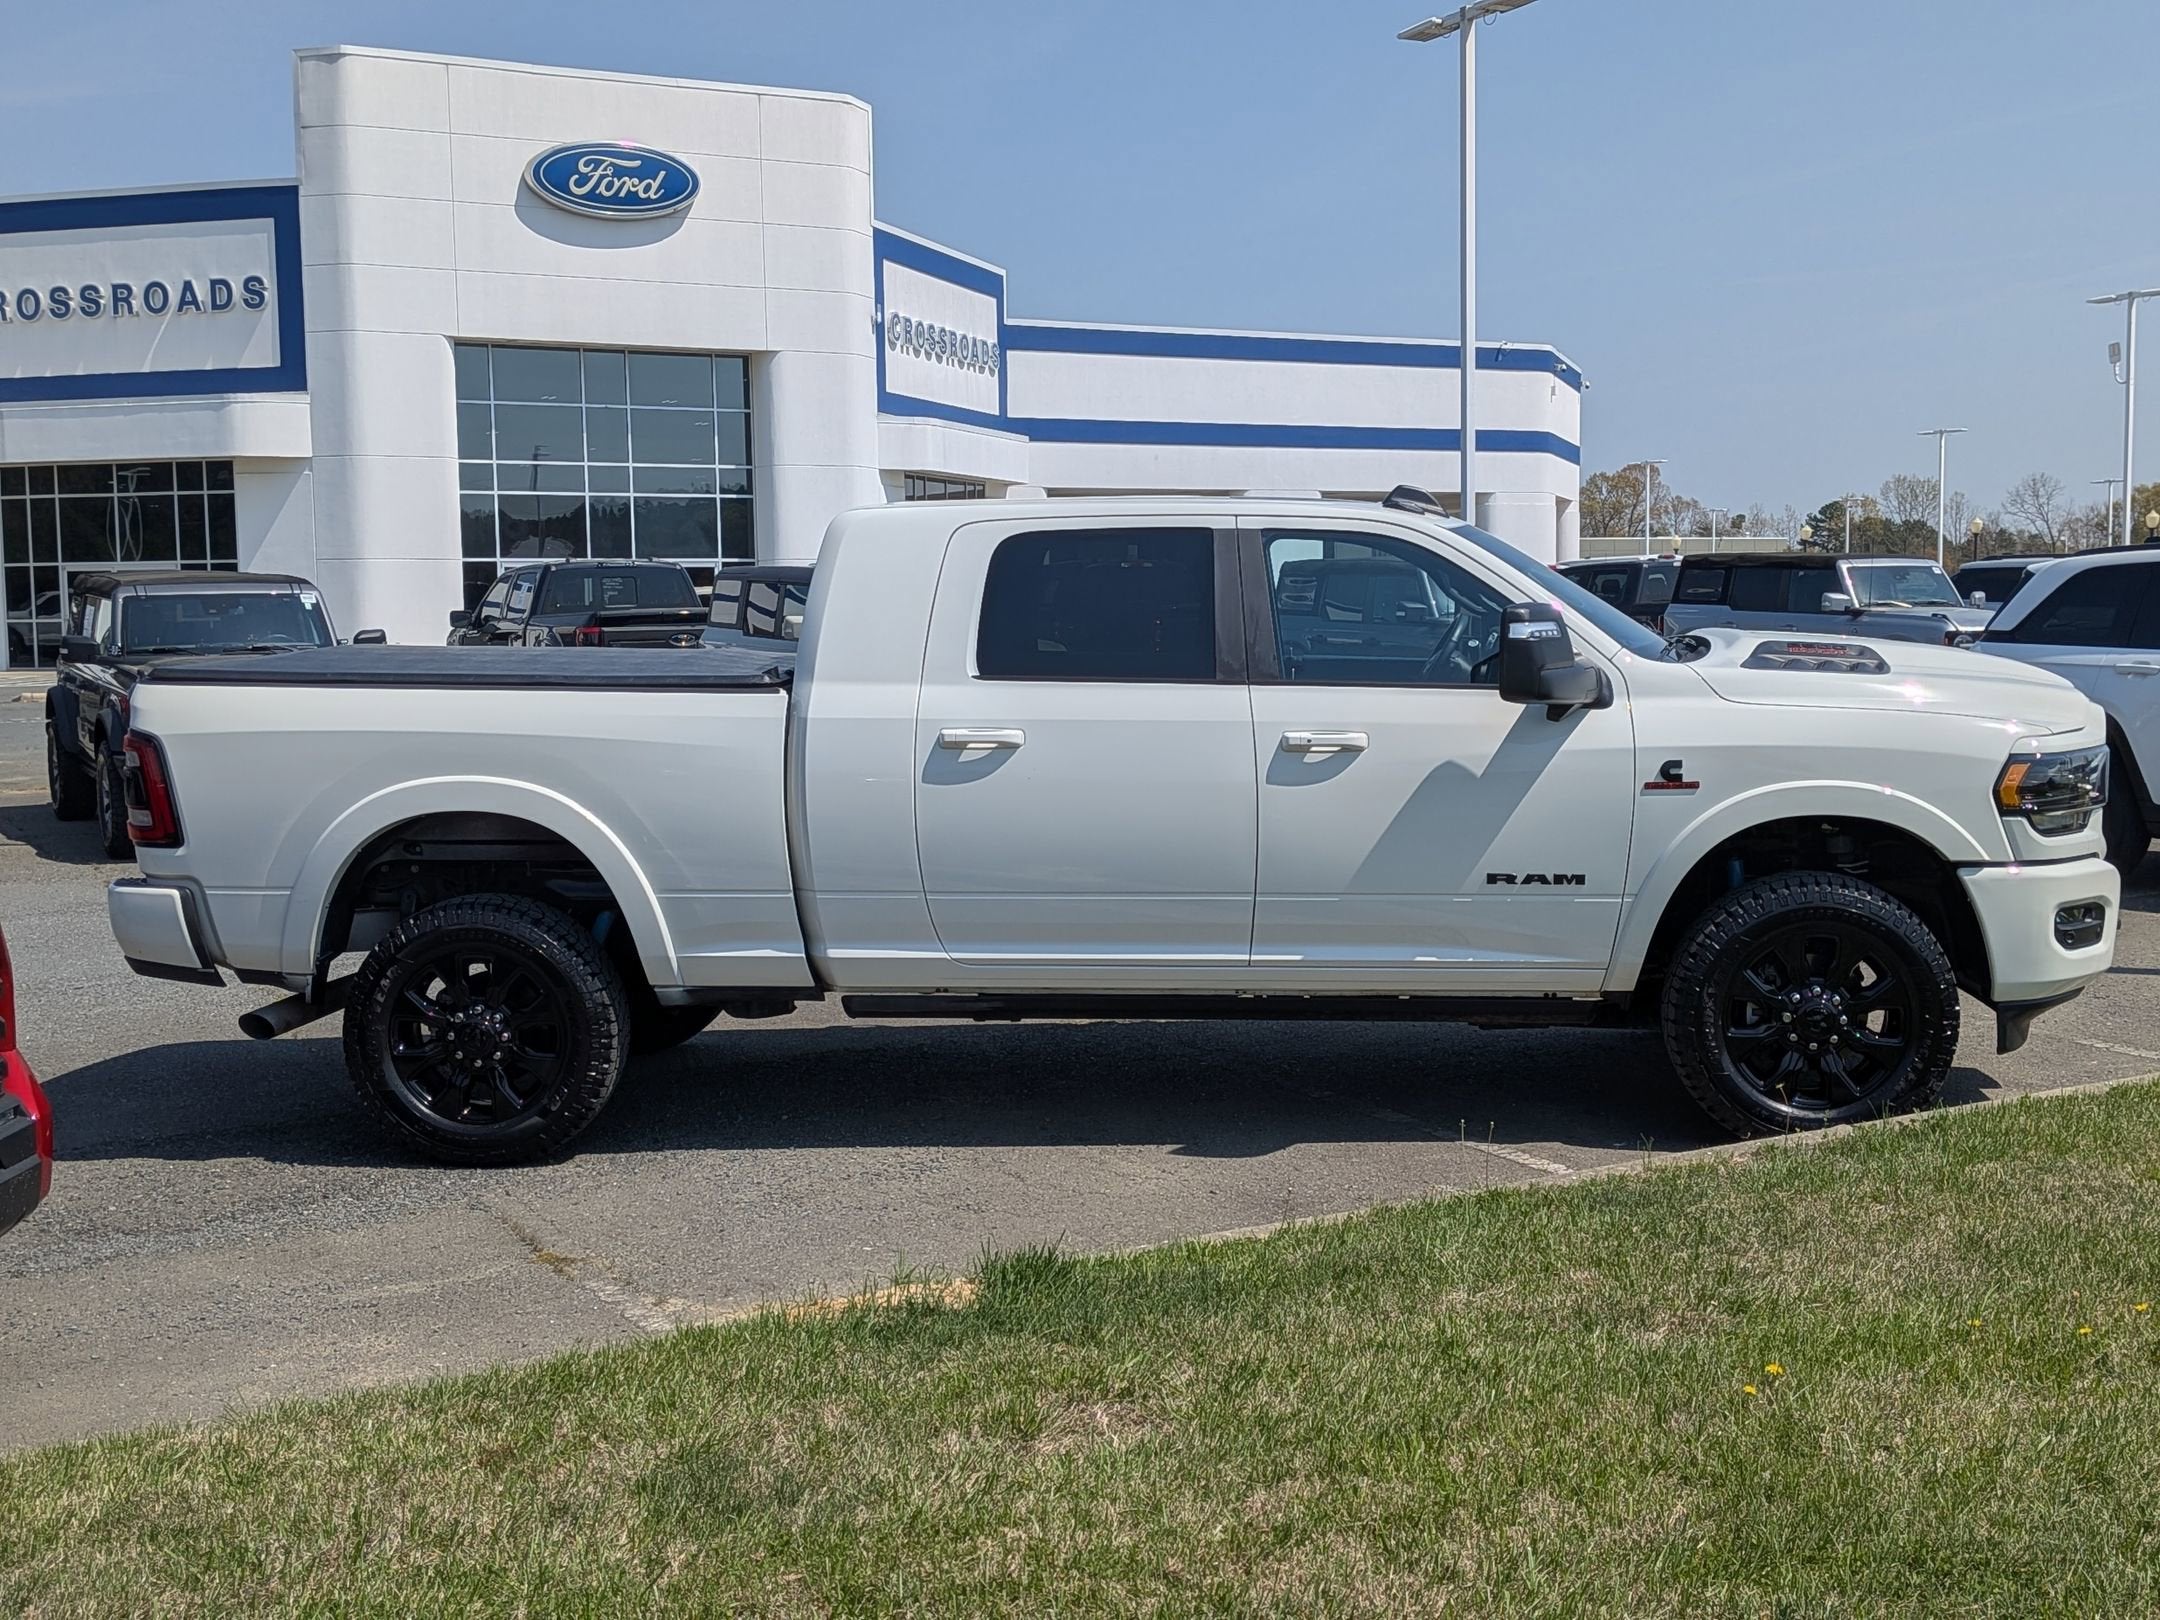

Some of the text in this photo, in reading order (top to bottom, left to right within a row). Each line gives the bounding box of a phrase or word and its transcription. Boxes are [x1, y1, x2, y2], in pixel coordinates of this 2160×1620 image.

[568, 154, 667, 200] Ford
[889, 311, 1001, 370] CROSSROADS
[1486, 872, 1586, 886] RAM
